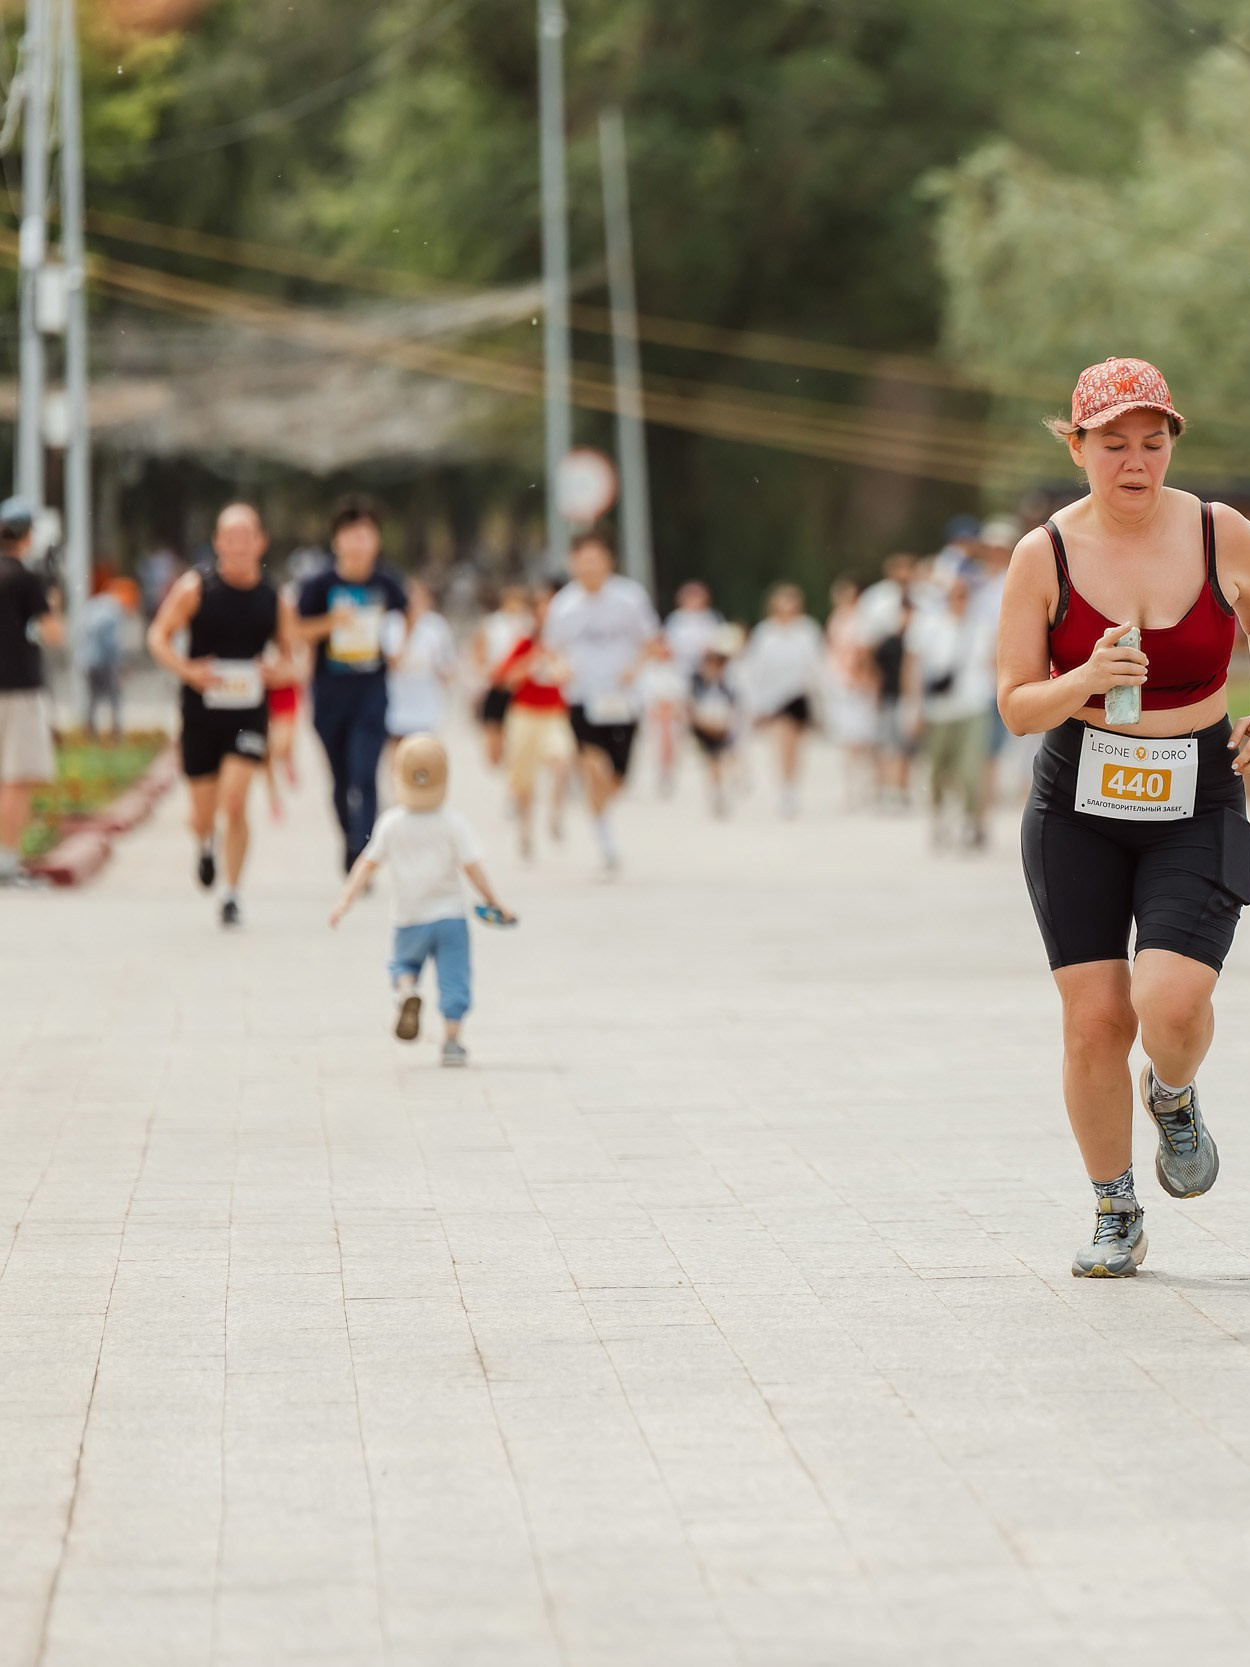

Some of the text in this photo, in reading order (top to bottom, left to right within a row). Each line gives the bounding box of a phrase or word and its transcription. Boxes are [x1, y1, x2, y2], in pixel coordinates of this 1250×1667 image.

[1091, 741, 1187, 760] LEONE D'ORO
[1107, 770, 1164, 798] 440
[1087, 798, 1161, 812] БЛАГОТВОРИТЕЛЬНЫЙ
